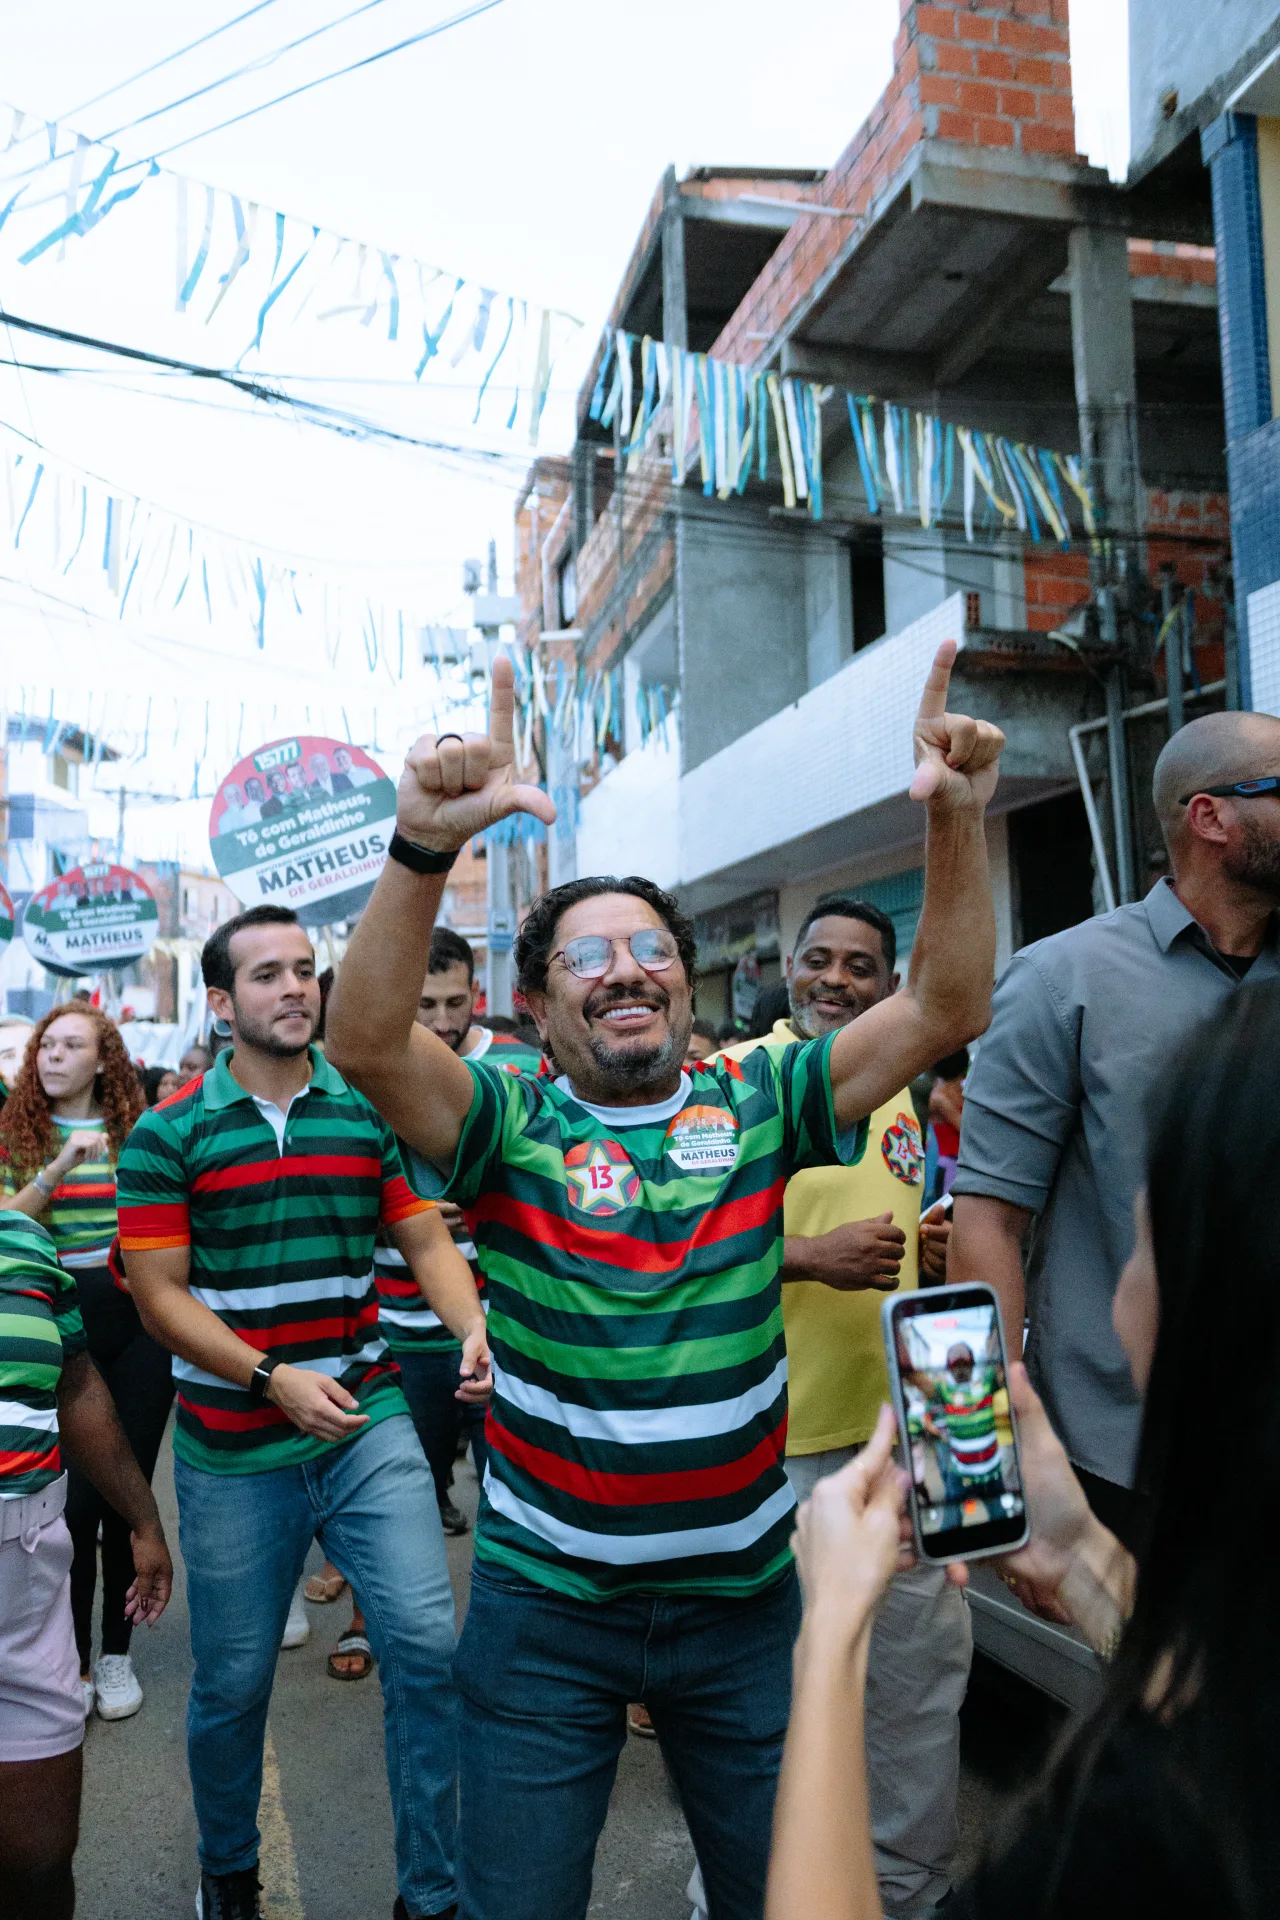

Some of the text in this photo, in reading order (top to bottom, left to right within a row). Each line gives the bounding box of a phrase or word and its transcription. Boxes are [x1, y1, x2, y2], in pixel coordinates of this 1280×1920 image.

[255, 741, 298, 771] 15777
[236, 793, 372, 847] Tô com Matheus,
[255, 811, 366, 858] de Geraldinho
[258, 834, 386, 895] MATHEUS
[288, 885, 305, 898] DE
[66, 928, 143, 949] MATHEUS
[691, 1138, 731, 1147] Geraldinho
[702, 1131, 735, 1139] Matheus,
[681, 1148, 736, 1161] MATHEUS
[588, 1165, 614, 1190] 13
